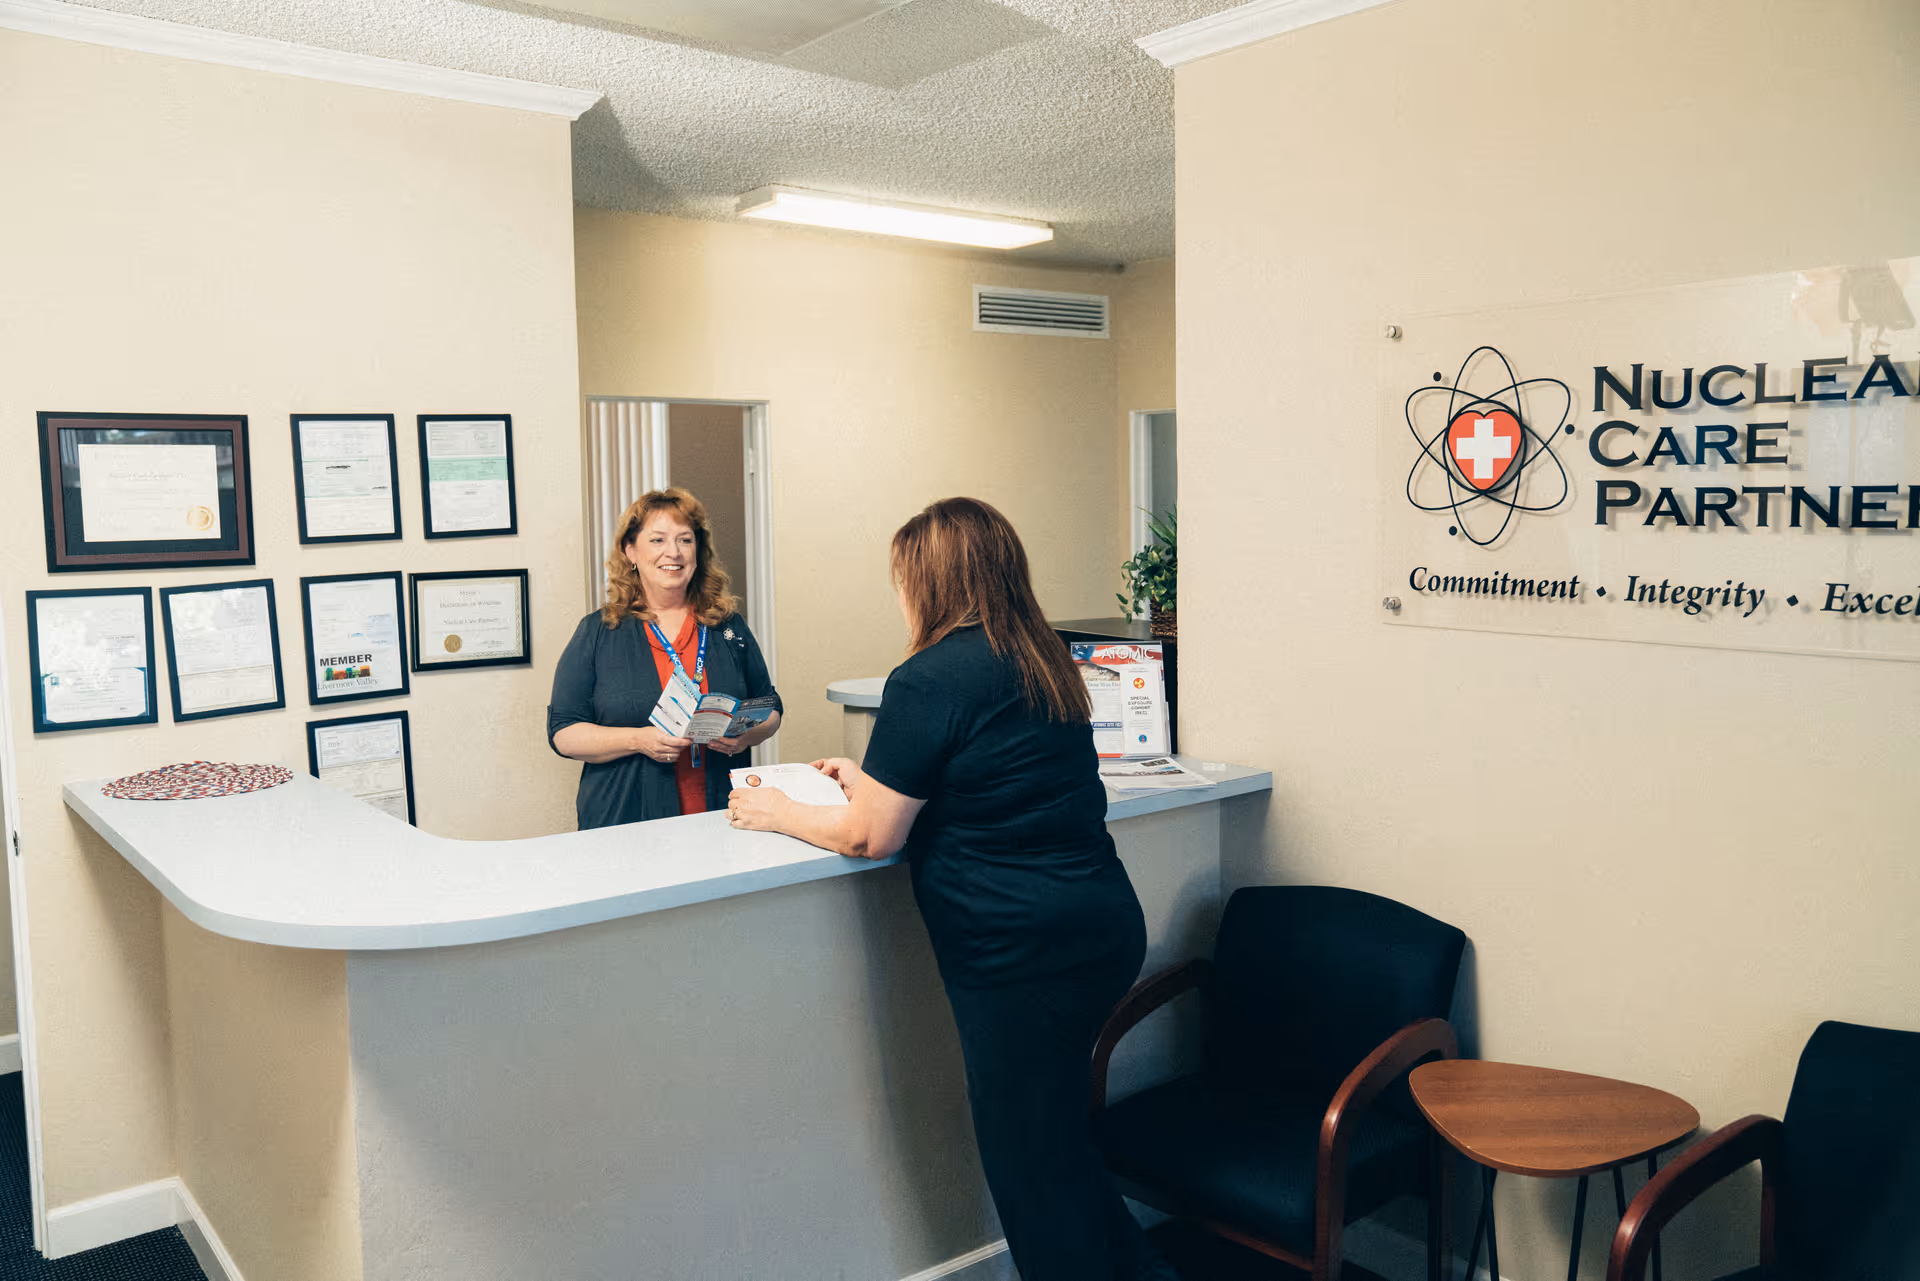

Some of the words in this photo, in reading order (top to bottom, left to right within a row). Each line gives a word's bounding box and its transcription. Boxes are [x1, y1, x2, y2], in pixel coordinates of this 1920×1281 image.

[1592, 353, 1920, 412] NUCLEA
[1588, 420, 1789, 467] CARE
[1409, 566, 1581, 599] Commitment
[1624, 575, 1766, 618] Integrity
[319, 653, 373, 667] MEMBER
[696, 656, 704, 674] NCP
[1101, 647, 1154, 660] ATOMIC
